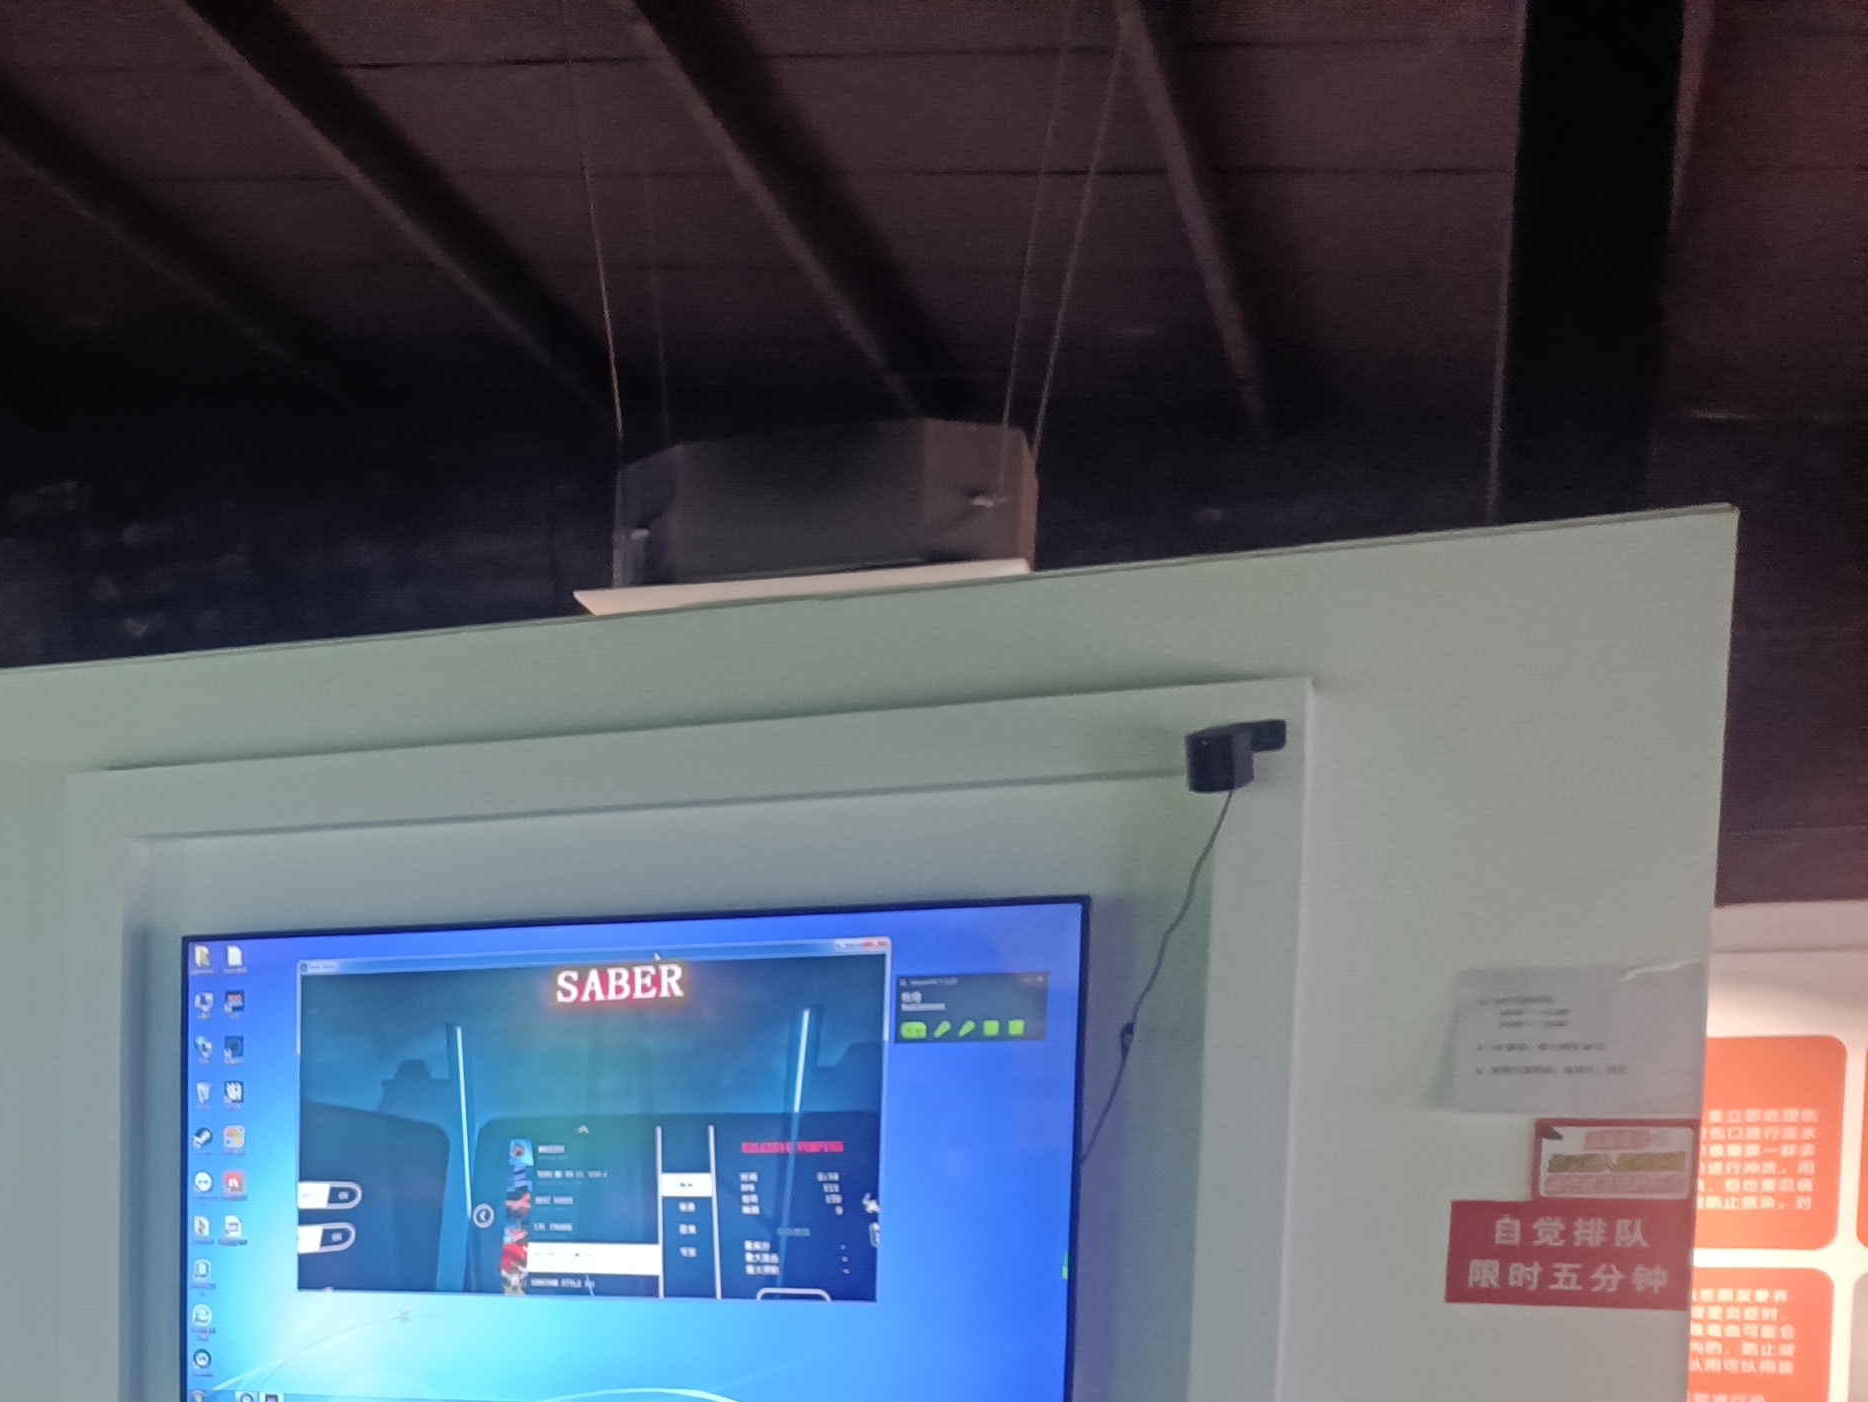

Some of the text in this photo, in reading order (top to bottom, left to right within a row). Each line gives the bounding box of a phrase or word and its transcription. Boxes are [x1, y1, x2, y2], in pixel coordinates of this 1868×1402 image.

[556, 963, 685, 1003] SABER
[1494, 1214, 1649, 1248] 自觉排队
[1467, 1258, 1669, 1295] 限时五分钟
